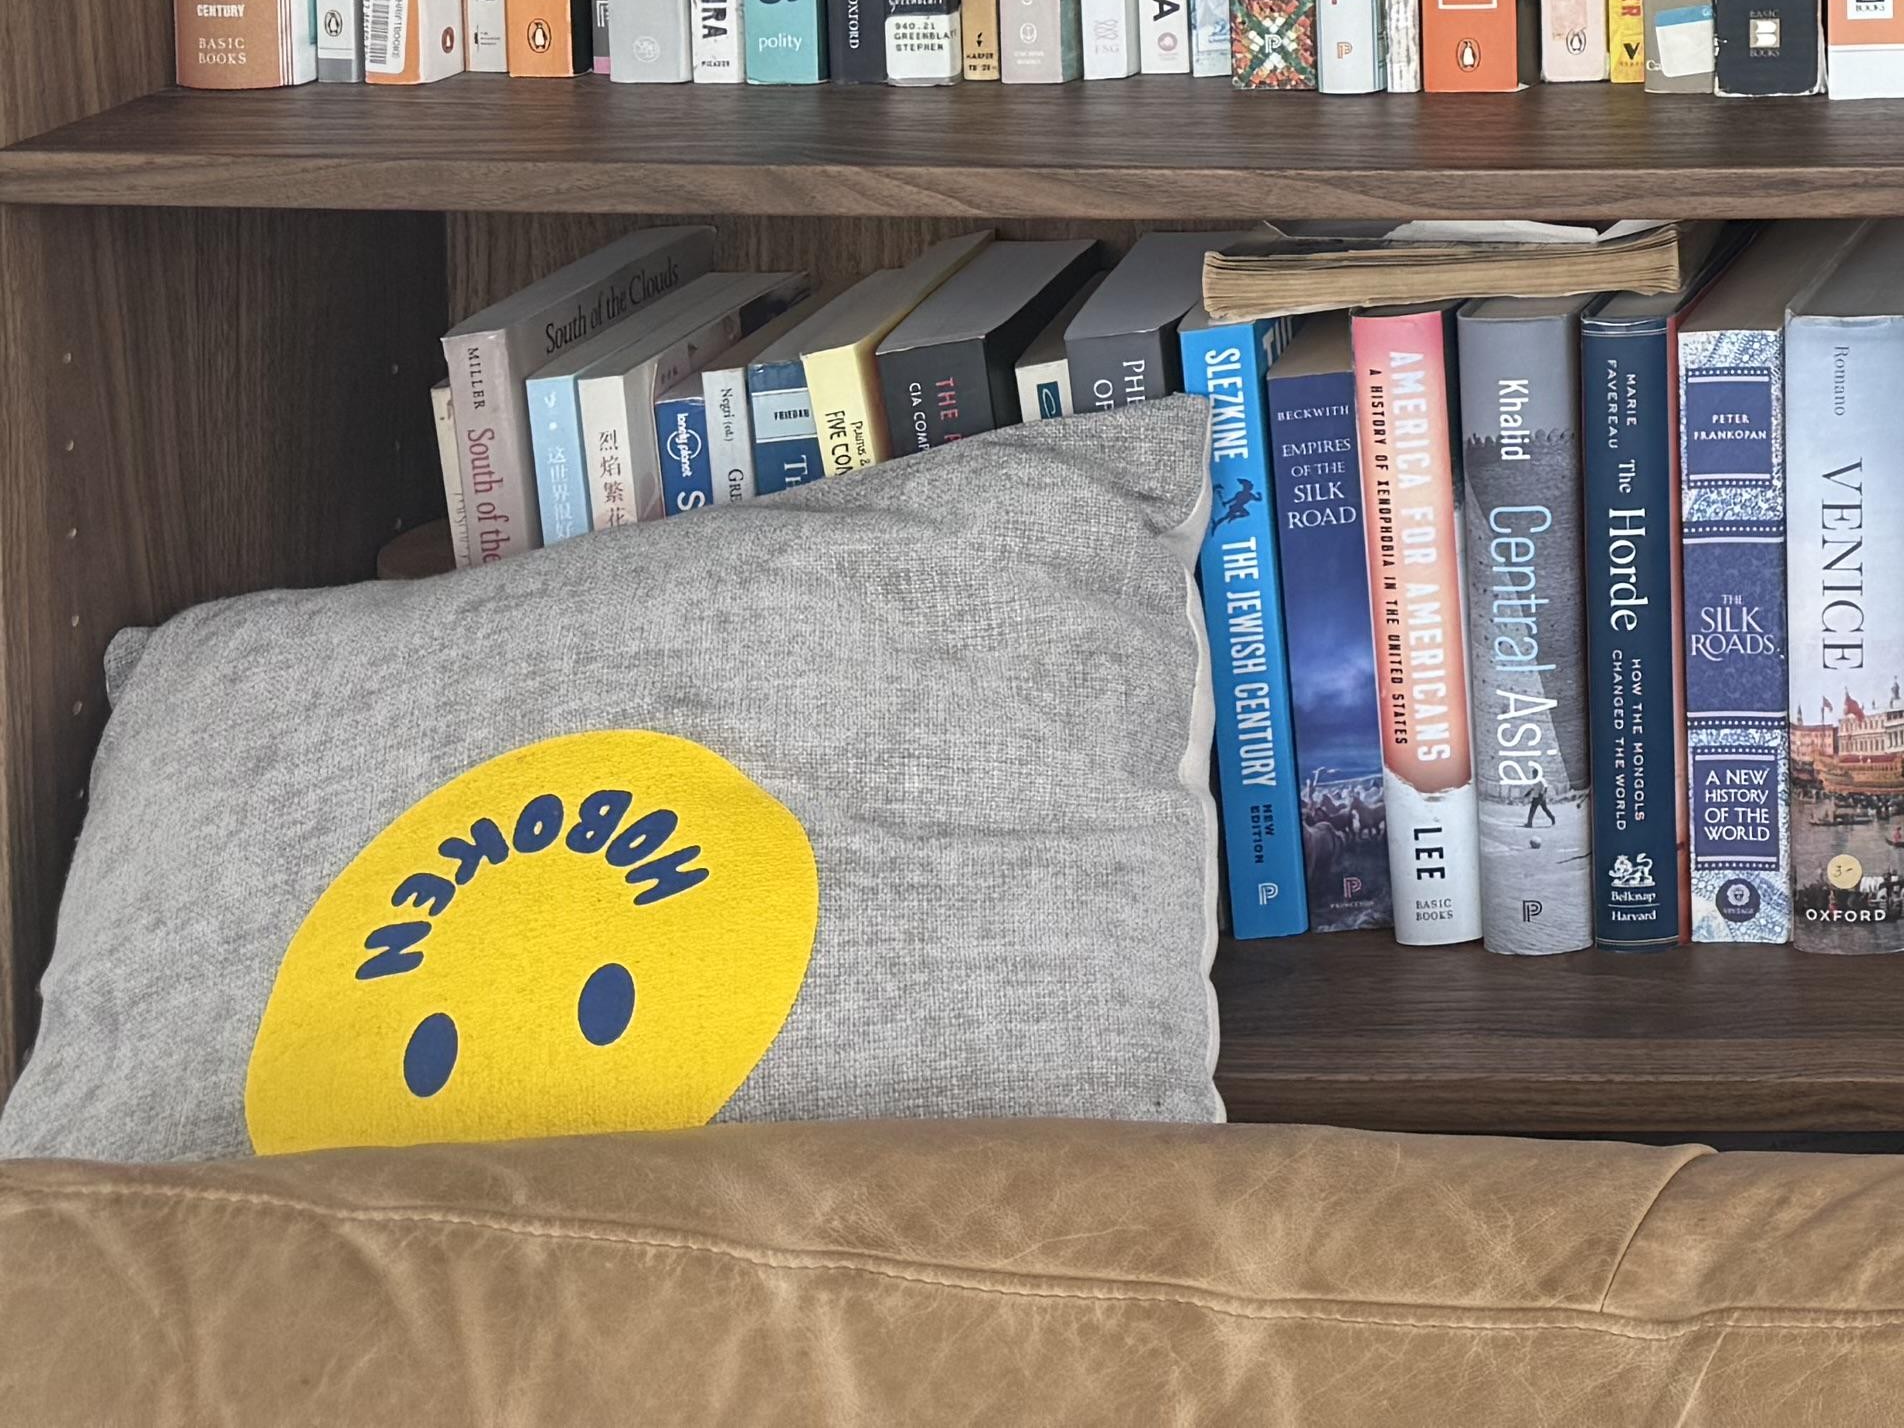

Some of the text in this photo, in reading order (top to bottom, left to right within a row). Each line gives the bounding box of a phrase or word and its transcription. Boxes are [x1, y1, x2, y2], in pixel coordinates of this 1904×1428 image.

[757, 31, 803, 55] polity
[466, 347, 485, 411] MILLER
[1276, 403, 1350, 423] BECKWITH
[1281, 438, 1352, 460] EMPIRES
[1294, 483, 1346, 504] SILK
[1287, 505, 1357, 528] ROAD
[1816, 457, 1865, 671] VENICE
[1700, 606, 1760, 634] SILK
[1691, 633, 1778, 659] ROADS
[1409, 825, 1444, 883] LEE
[354, 788, 710, 981] HOBOKEN
[1805, 906, 1887, 924] OXFORD
